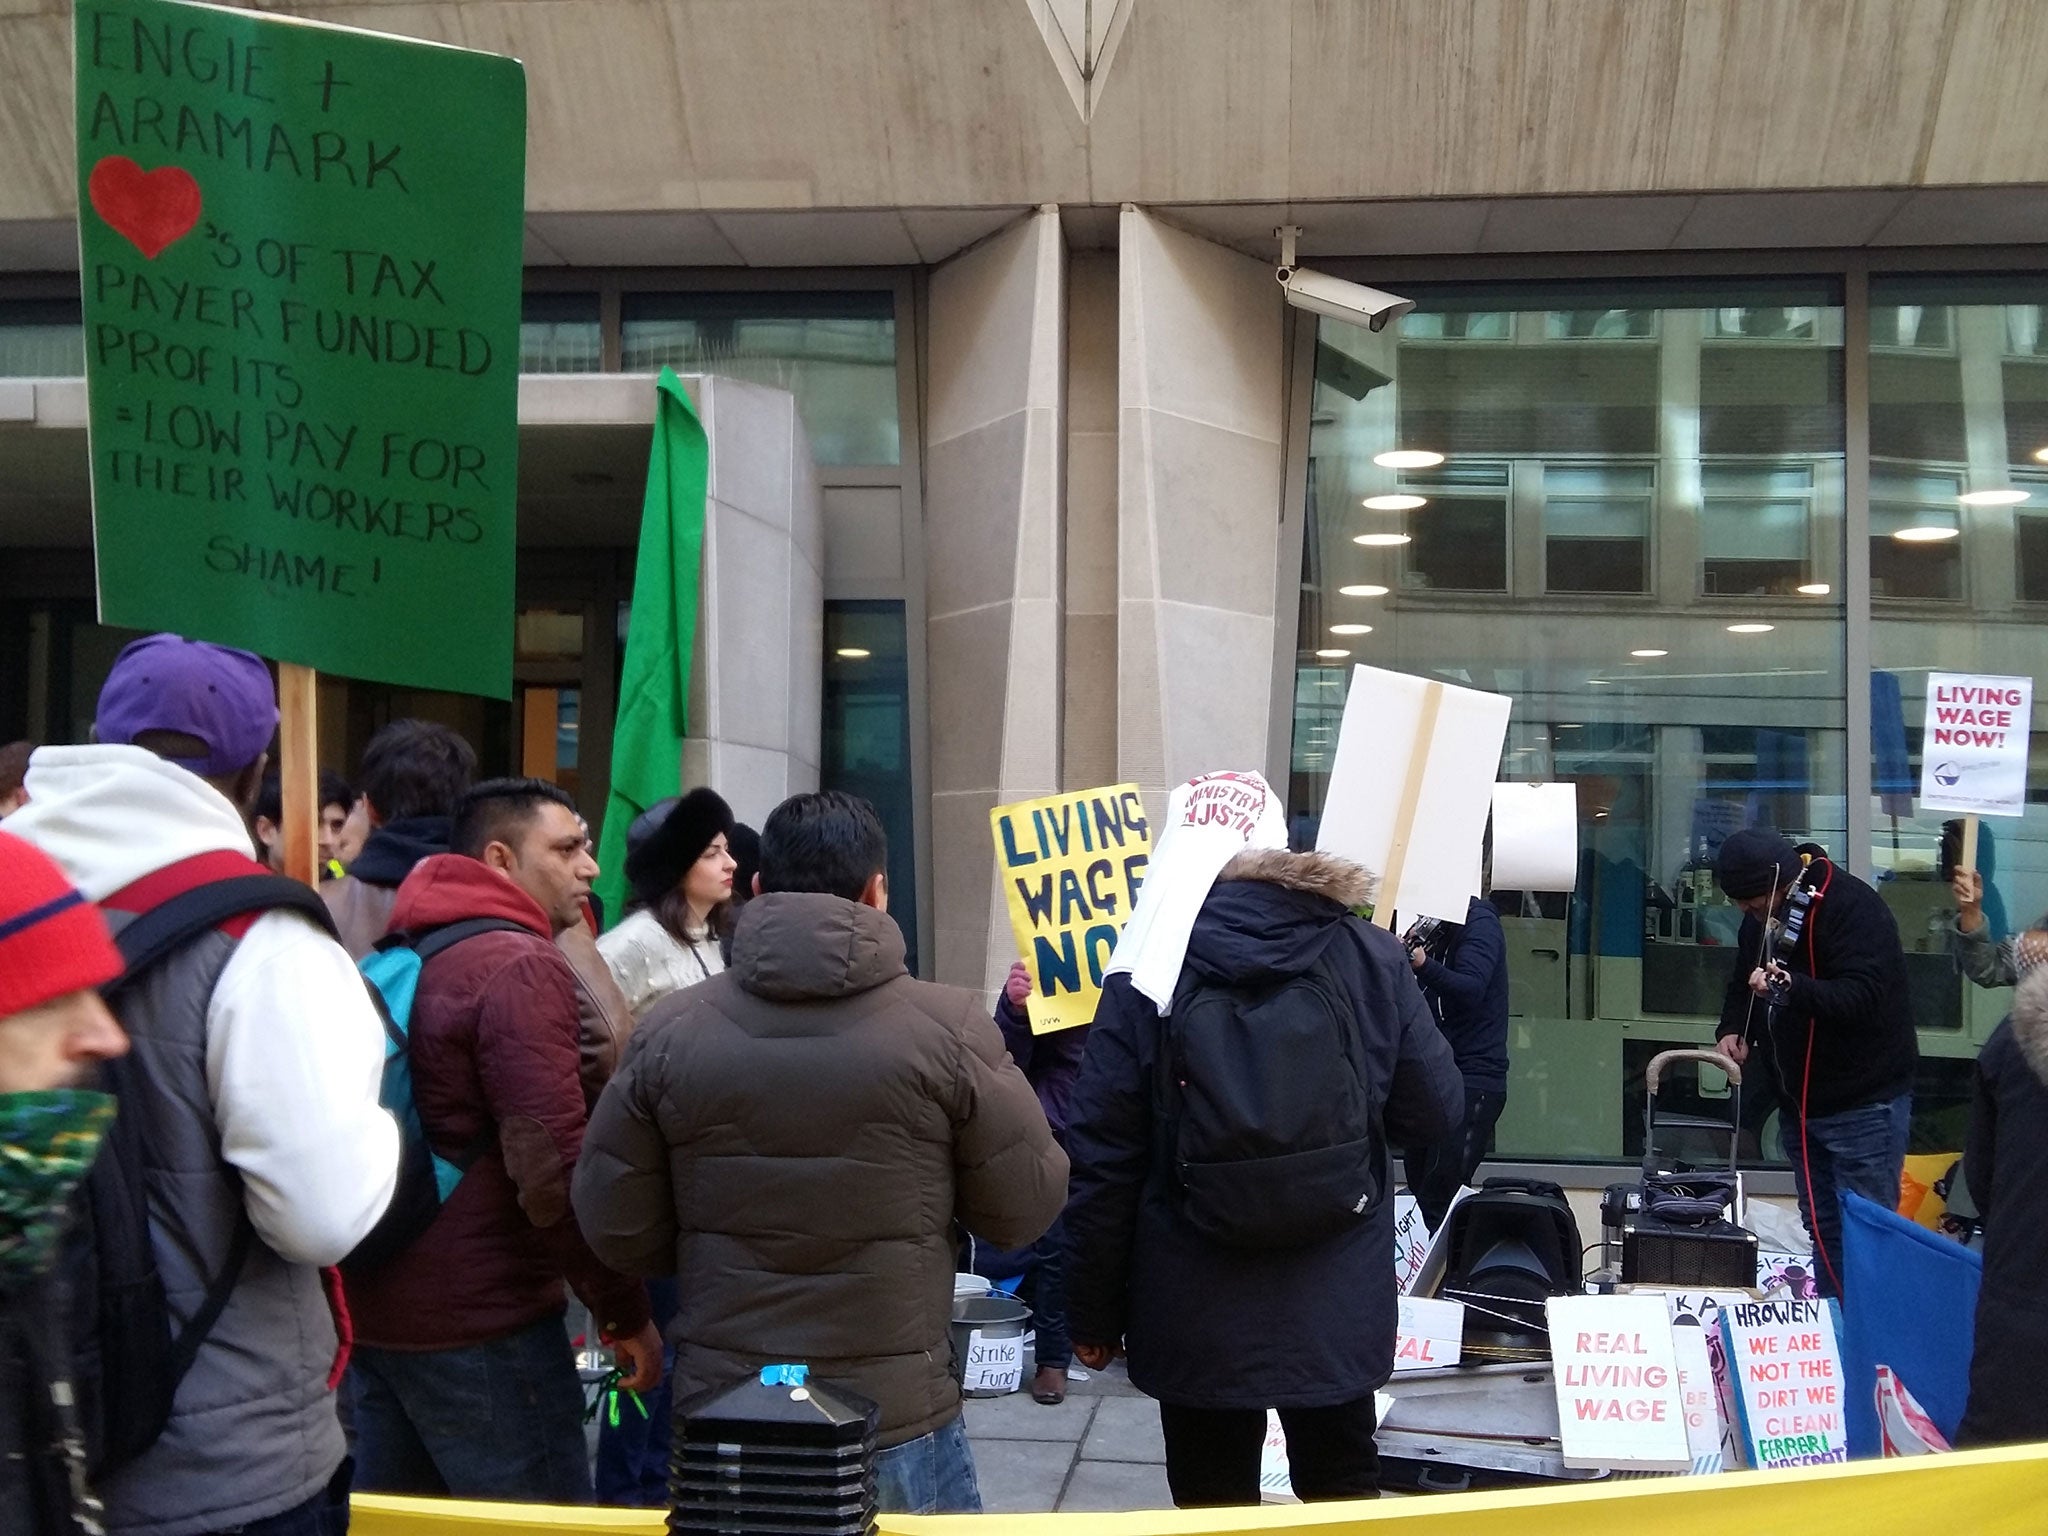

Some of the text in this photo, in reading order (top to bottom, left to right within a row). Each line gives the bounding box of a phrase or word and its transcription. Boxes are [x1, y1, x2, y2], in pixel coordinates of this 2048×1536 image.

[90, 11, 275, 103] ENGIE
[89, 90, 409, 194] ARAMARK
[255, 238, 314, 284] OF
[331, 249, 445, 305] TAX
[95, 263, 493, 376] PAYER FUNDED
[95, 323, 301, 409] PROFITS
[265, 411, 358, 472] PAY
[381, 433, 491, 492] FOR
[106, 450, 484, 545] THEIR WORKERS
[1937, 686, 2022, 706] LIVING
[1936, 707, 2011, 727] WAGE
[1935, 728, 2005, 748] NOW!
[999, 792, 1148, 869] LIVING
[1033, 923, 1129, 999] NO
[1576, 1333, 1648, 1354] REAL
[1749, 1333, 1821, 1355] WE ARE
[979, 1368, 1016, 1387] Fund
[1565, 1365, 1668, 1388] LIVING
[1750, 1359, 1833, 1382] NOT THE
[1758, 1385, 1836, 1409] DIRT WE
[1575, 1399, 1667, 1422] WAGE
[1766, 1412, 1838, 1436] CLEAN!
[1758, 1431, 1829, 1461] FERRARI
